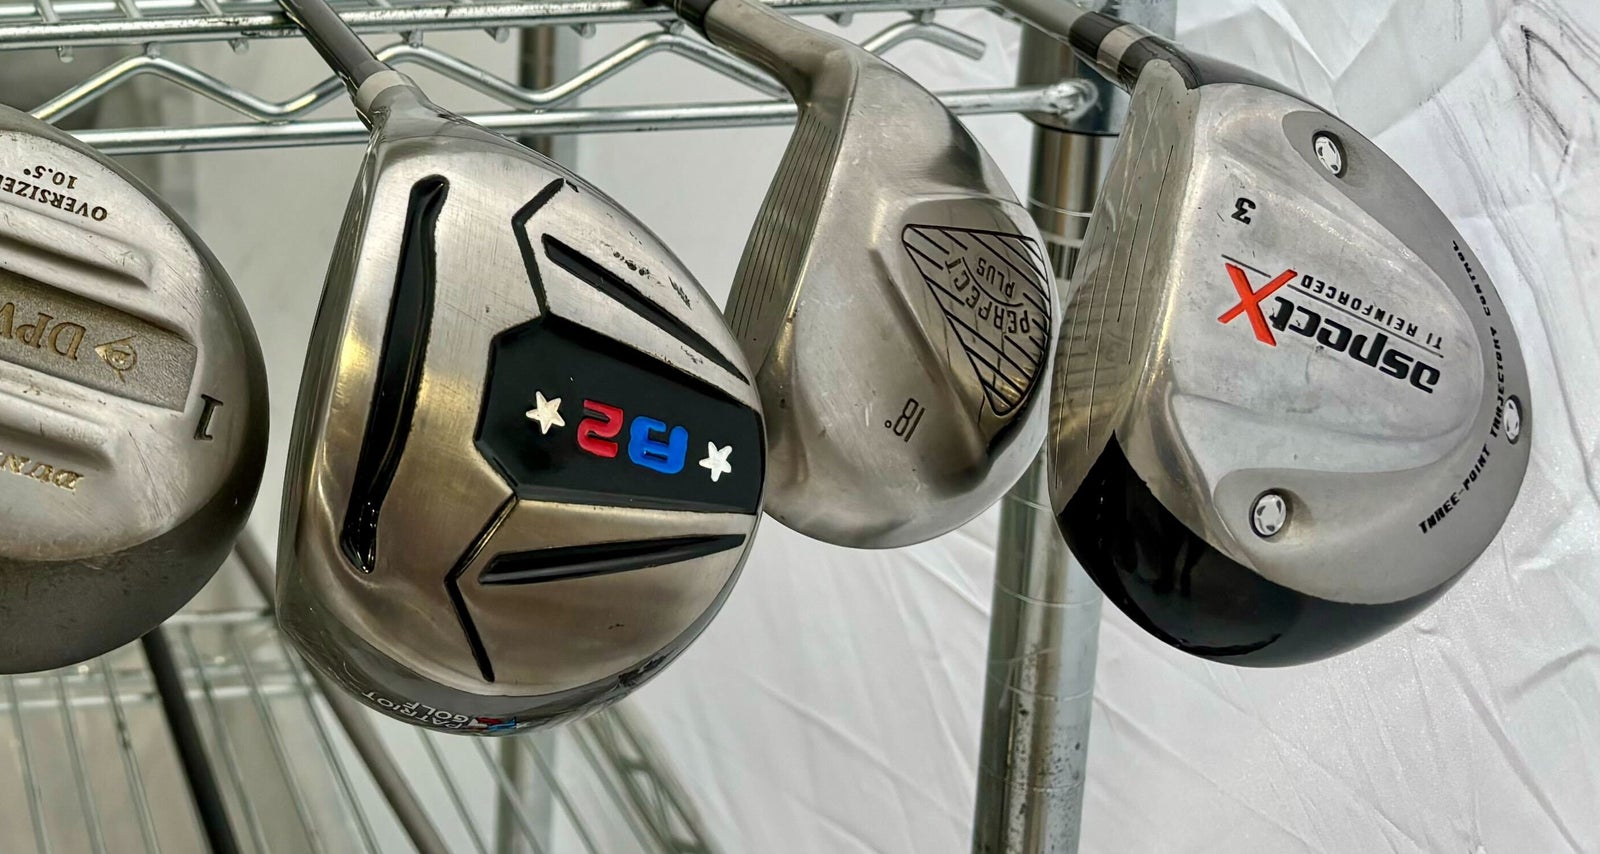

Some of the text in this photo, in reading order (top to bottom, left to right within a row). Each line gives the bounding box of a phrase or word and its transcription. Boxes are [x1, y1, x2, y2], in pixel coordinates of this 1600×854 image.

[22, 164, 78, 190] 10.5°
[1230, 197, 1256, 225] 3
[944, 256, 1031, 334] PERFECT
[977, 255, 1017, 296] PLUS
[1300, 273, 1442, 349] TI REINFORCED
[1419, 240, 1505, 533] THREE-POINT TRAJECTORY CONTROL
[194, 393, 225, 441] 1
[576, 399, 689, 475] B2
[362, 691, 463, 729] PATRIOT
[403, 702, 469, 723] GOLF
